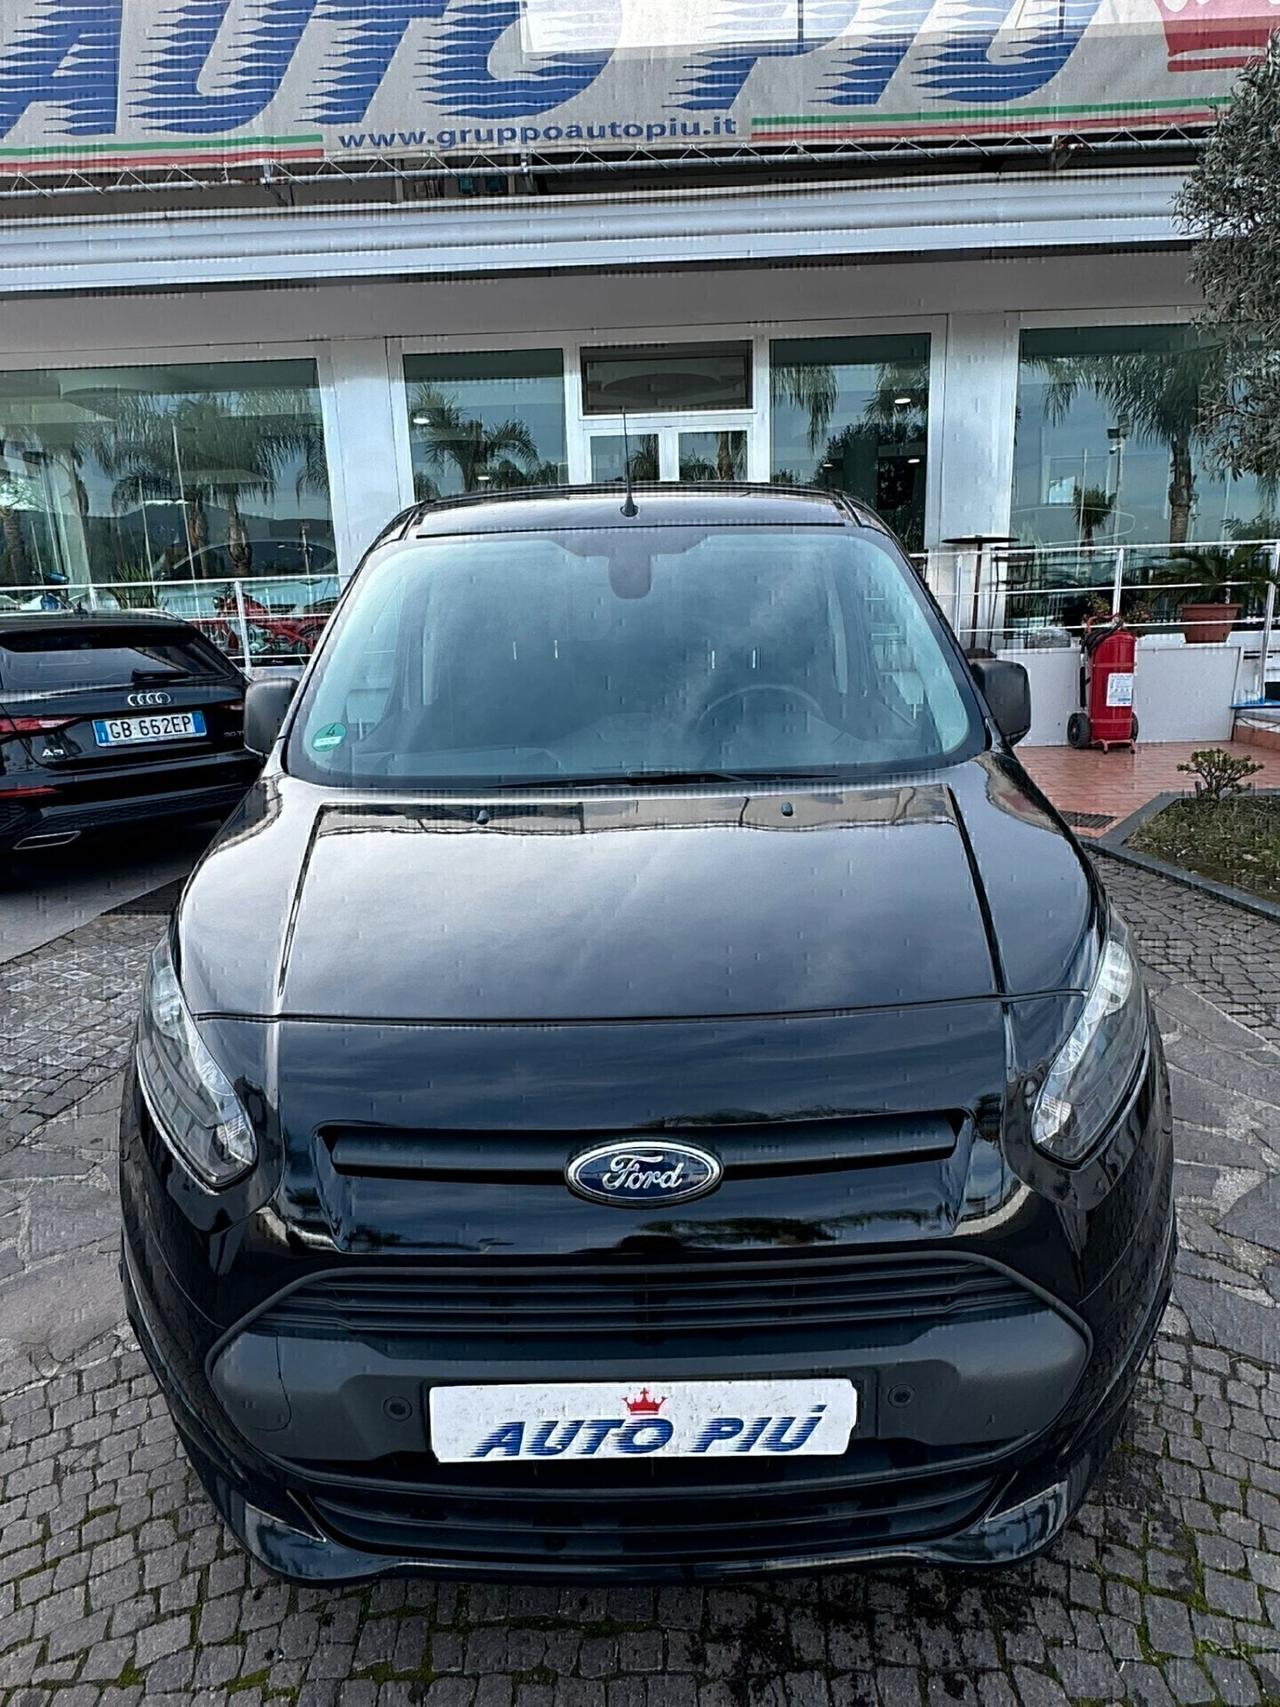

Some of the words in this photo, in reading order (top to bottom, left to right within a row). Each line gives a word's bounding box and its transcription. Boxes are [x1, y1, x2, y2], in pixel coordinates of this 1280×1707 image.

[338, 116, 737, 149] www.gruppoautopiu.it
[109, 721, 132, 739] GB
[138, 715, 191, 737] 662EP
[326, 723, 336, 737] 4
[602, 1154, 684, 1190] Ford
[470, 1418, 674, 1458] AUTO
